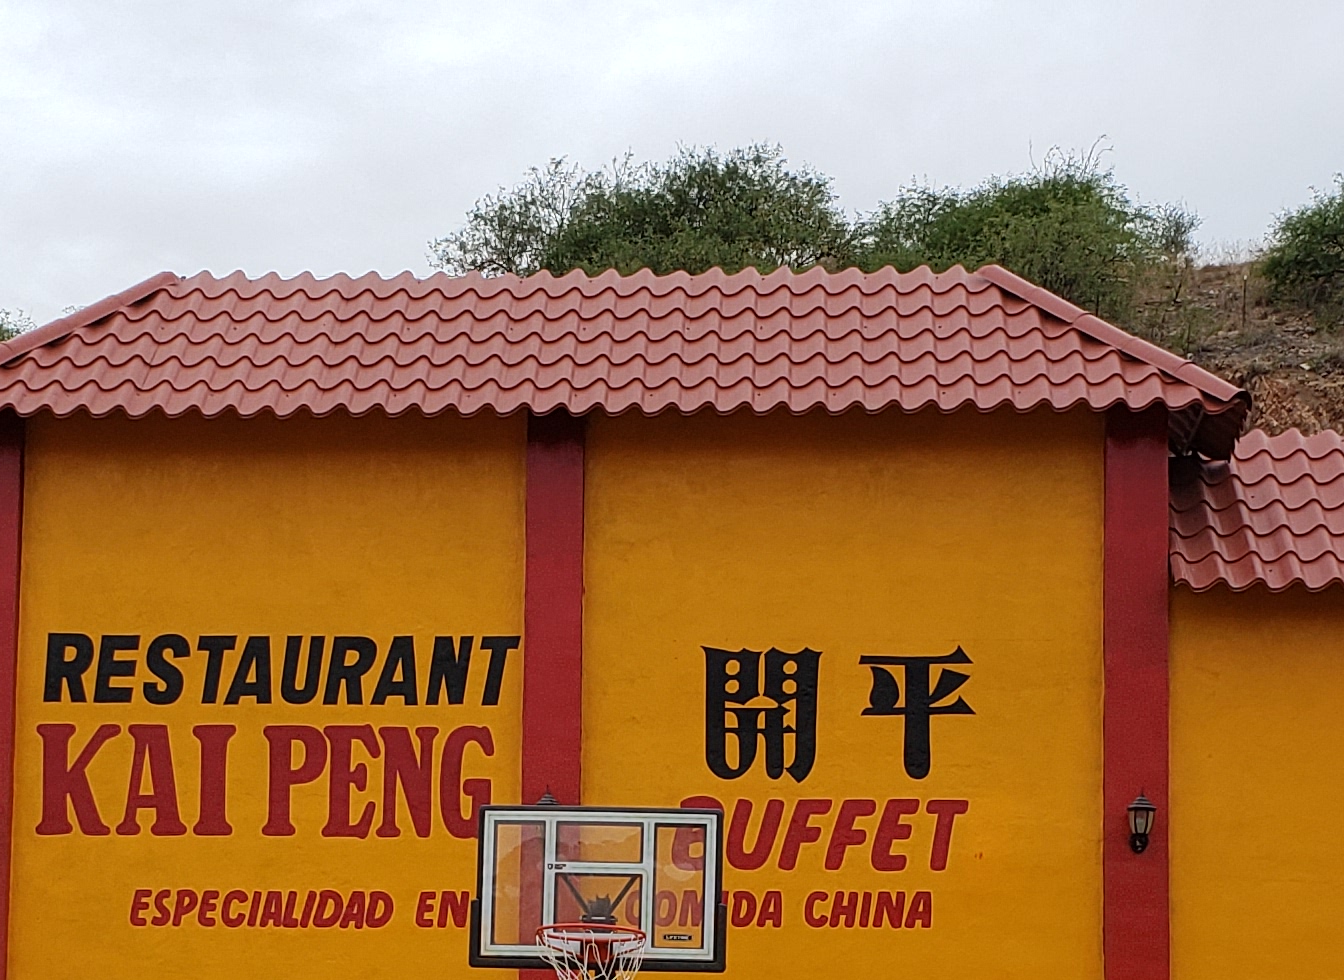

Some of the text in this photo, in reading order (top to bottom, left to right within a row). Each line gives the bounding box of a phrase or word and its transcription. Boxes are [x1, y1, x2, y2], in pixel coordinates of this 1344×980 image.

[43, 633, 521, 706] RESTAURANT
[700, 645, 976, 783] 開平
[35, 723, 495, 838] KAI PENG
[671, 795, 969, 871] BUFFET
[129, 889, 395, 929] ESPECIALIDAD
[415, 890, 470, 928] EN
[804, 890, 933, 928] CHINA
